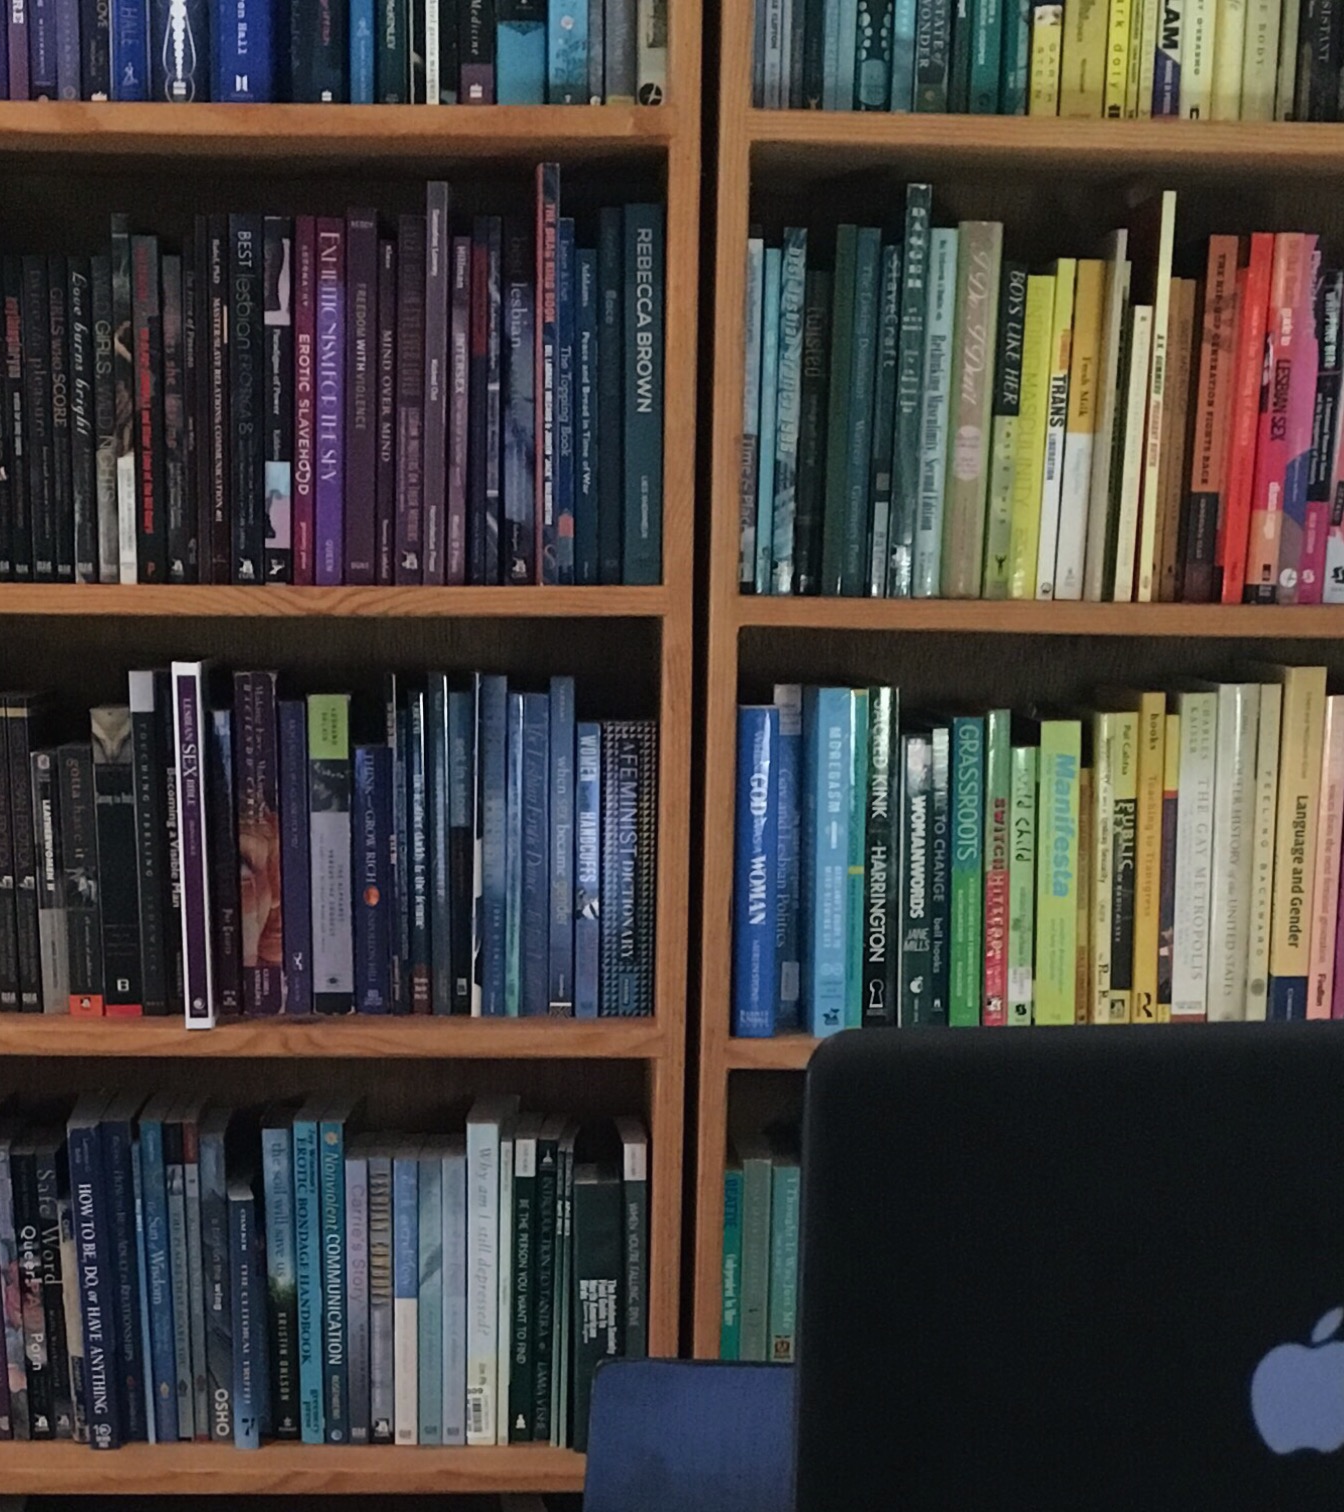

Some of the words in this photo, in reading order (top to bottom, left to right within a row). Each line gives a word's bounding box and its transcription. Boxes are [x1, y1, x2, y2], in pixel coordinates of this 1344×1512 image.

[120, 8, 137, 46] HALE
[1035, 46, 1044, 99] STEIN
[236, 231, 252, 268] BEST
[71, 272, 86, 316] Love
[636, 228, 652, 327] REBECCA
[234, 273, 254, 350] lesbian
[71, 322, 88, 371] burns
[298, 334, 309, 392] EROTIC
[381, 330, 392, 370] MIND
[637, 332, 652, 413] BROWN
[71, 378, 90, 436] bright
[381, 376, 392, 418] OVER
[1050, 375, 1067, 428] TRANS
[1273, 359, 1292, 416] LESBIAN
[295, 399, 311, 495] SLAVEHOOD
[381, 423, 392, 462] MIND
[1270, 416, 1287, 441] SEX
[181, 744, 196, 777] SEX
[620, 755, 637, 856] FEMINIST
[872, 774, 887, 818] KINK
[958, 725, 977, 860] GRASSROOTS
[1197, 779, 1209, 814] THE
[1052, 754, 1075, 897] Manifesta
[1195, 823, 1208, 858] GAY
[1289, 794, 1309, 864] Language
[909, 796, 926, 918] WOMANWORDS
[1291, 867, 1306, 894] and
[621, 860, 633, 959] DICTIONARY
[869, 846, 887, 962] HARRINGTON
[1192, 867, 1205, 980] METROPOLIS
[1288, 897, 1305, 949] Gender
[79, 1184, 94, 1218] HOW
[324, 1151, 338, 1230] Nonviolent
[80, 1243, 96, 1264] BE,
[81, 1221, 94, 1240] TO
[83, 1266, 97, 1289] DO,
[87, 1291, 98, 1304] or
[327, 1233, 342, 1365] COMMUNICATION
[87, 1306, 101, 1342] HAVE
[91, 1346, 107, 1414] ANYTHING
[214, 1389, 229, 1435] OSHO
